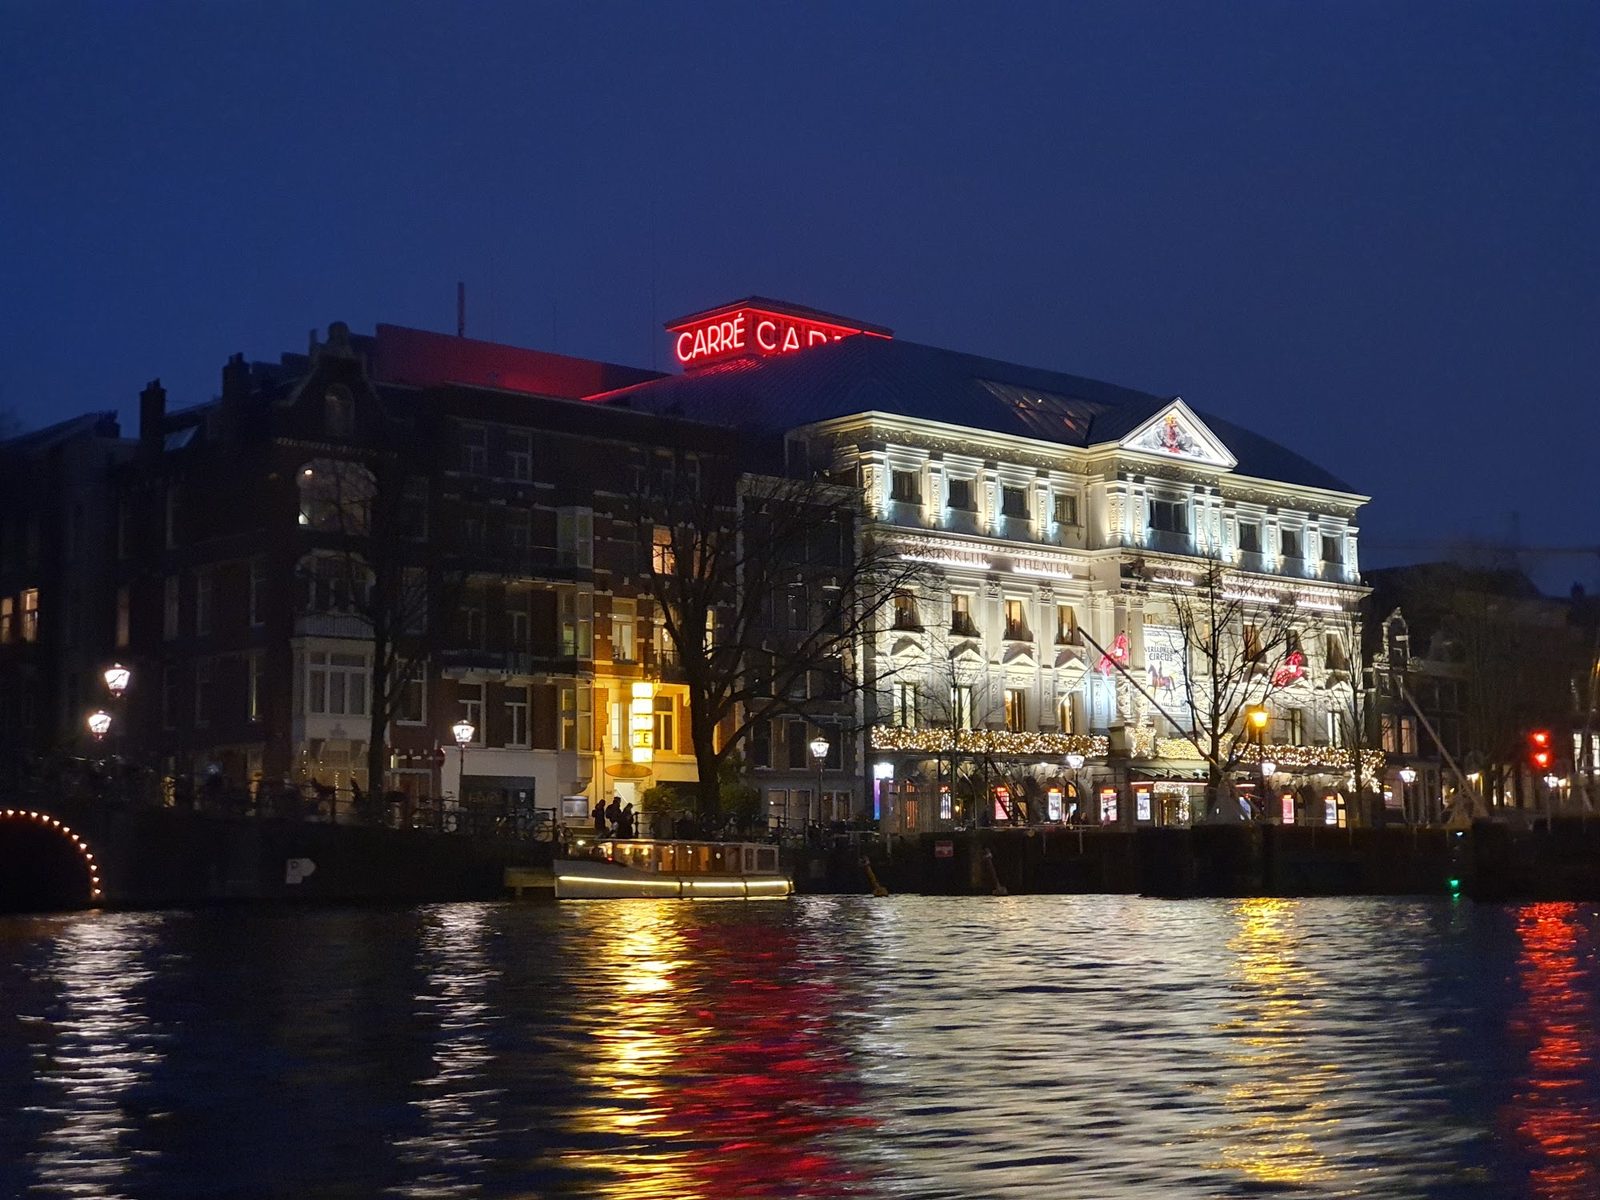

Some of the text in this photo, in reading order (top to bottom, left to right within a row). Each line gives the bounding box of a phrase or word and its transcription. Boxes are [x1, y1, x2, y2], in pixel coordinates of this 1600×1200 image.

[676, 312, 745, 361] CARRÉ
[757, 320, 842, 352] CAR
[1014, 556, 1072, 575] THEATER
[1148, 651, 1173, 662] CIRCUS
